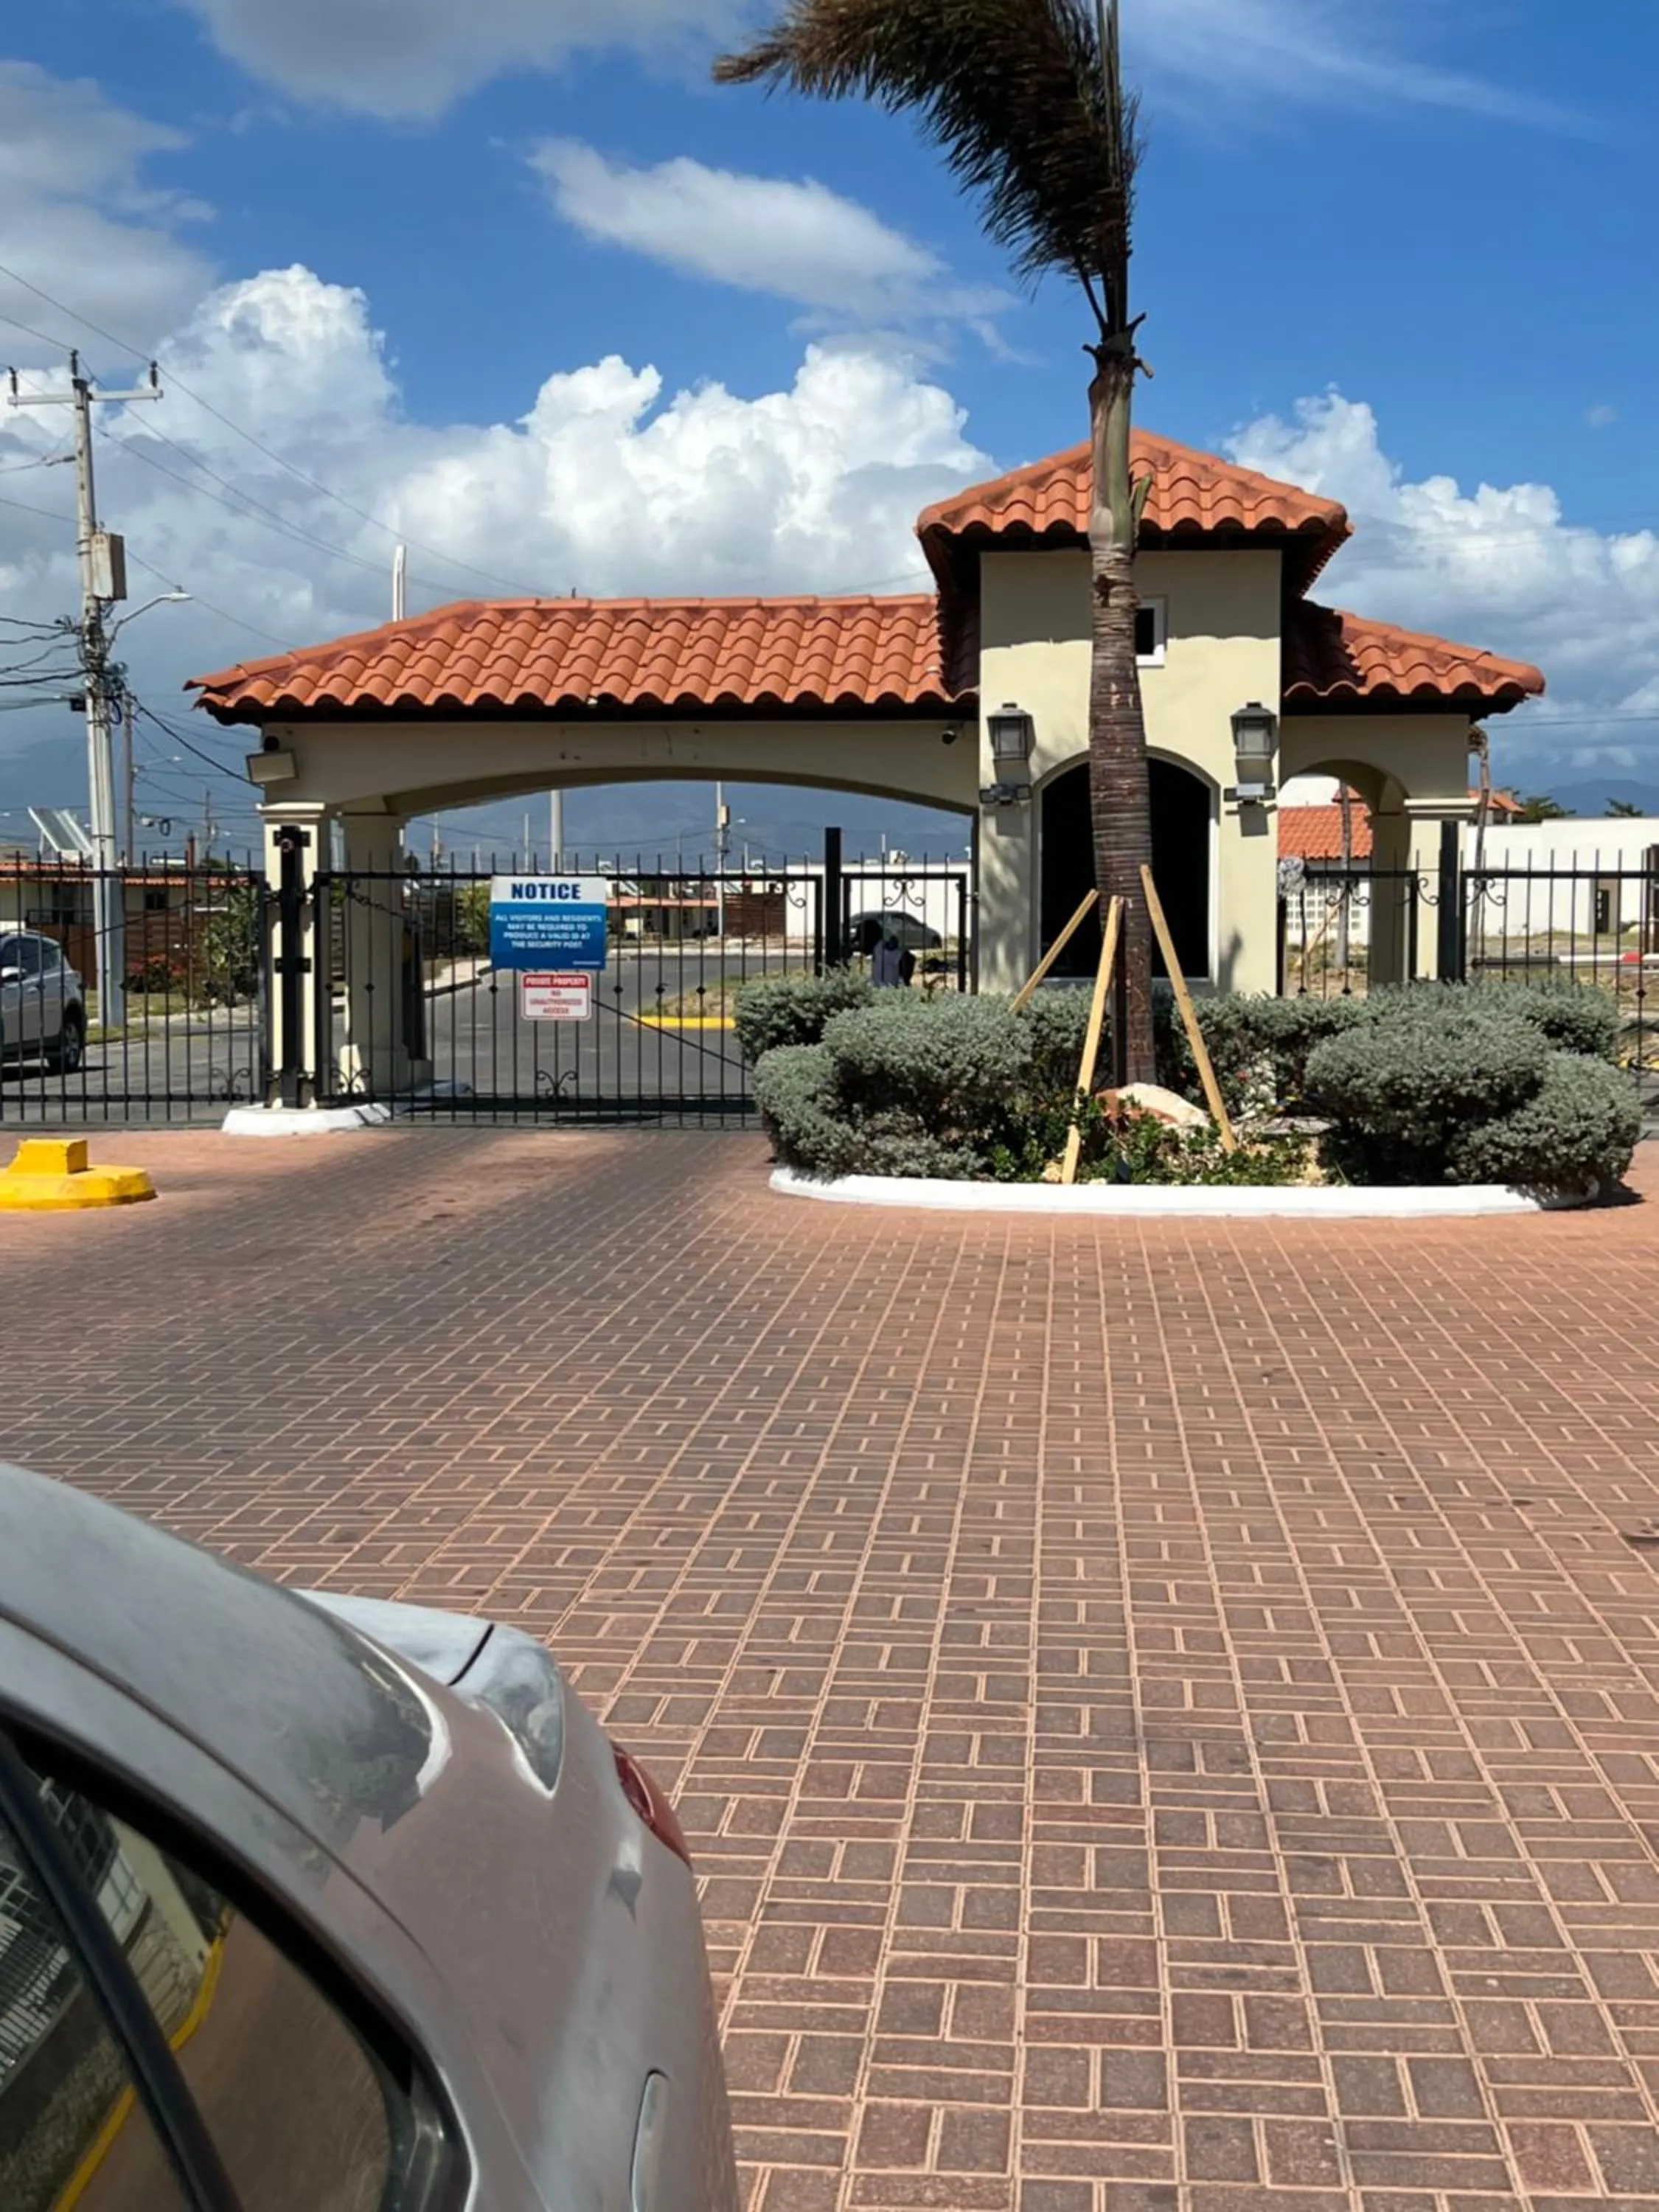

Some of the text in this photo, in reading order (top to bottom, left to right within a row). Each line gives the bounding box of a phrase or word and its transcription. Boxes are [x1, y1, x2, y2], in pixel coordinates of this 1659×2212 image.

[511, 883, 582, 900] NOTICE
[577, 923, 588, 931] TO
[571, 932, 580, 940] ID
[580, 932, 591, 940] AT
[511, 940, 526, 948] THE
[526, 940, 562, 948] SECURITY
[553, 977, 585, 986] PROPERTY
